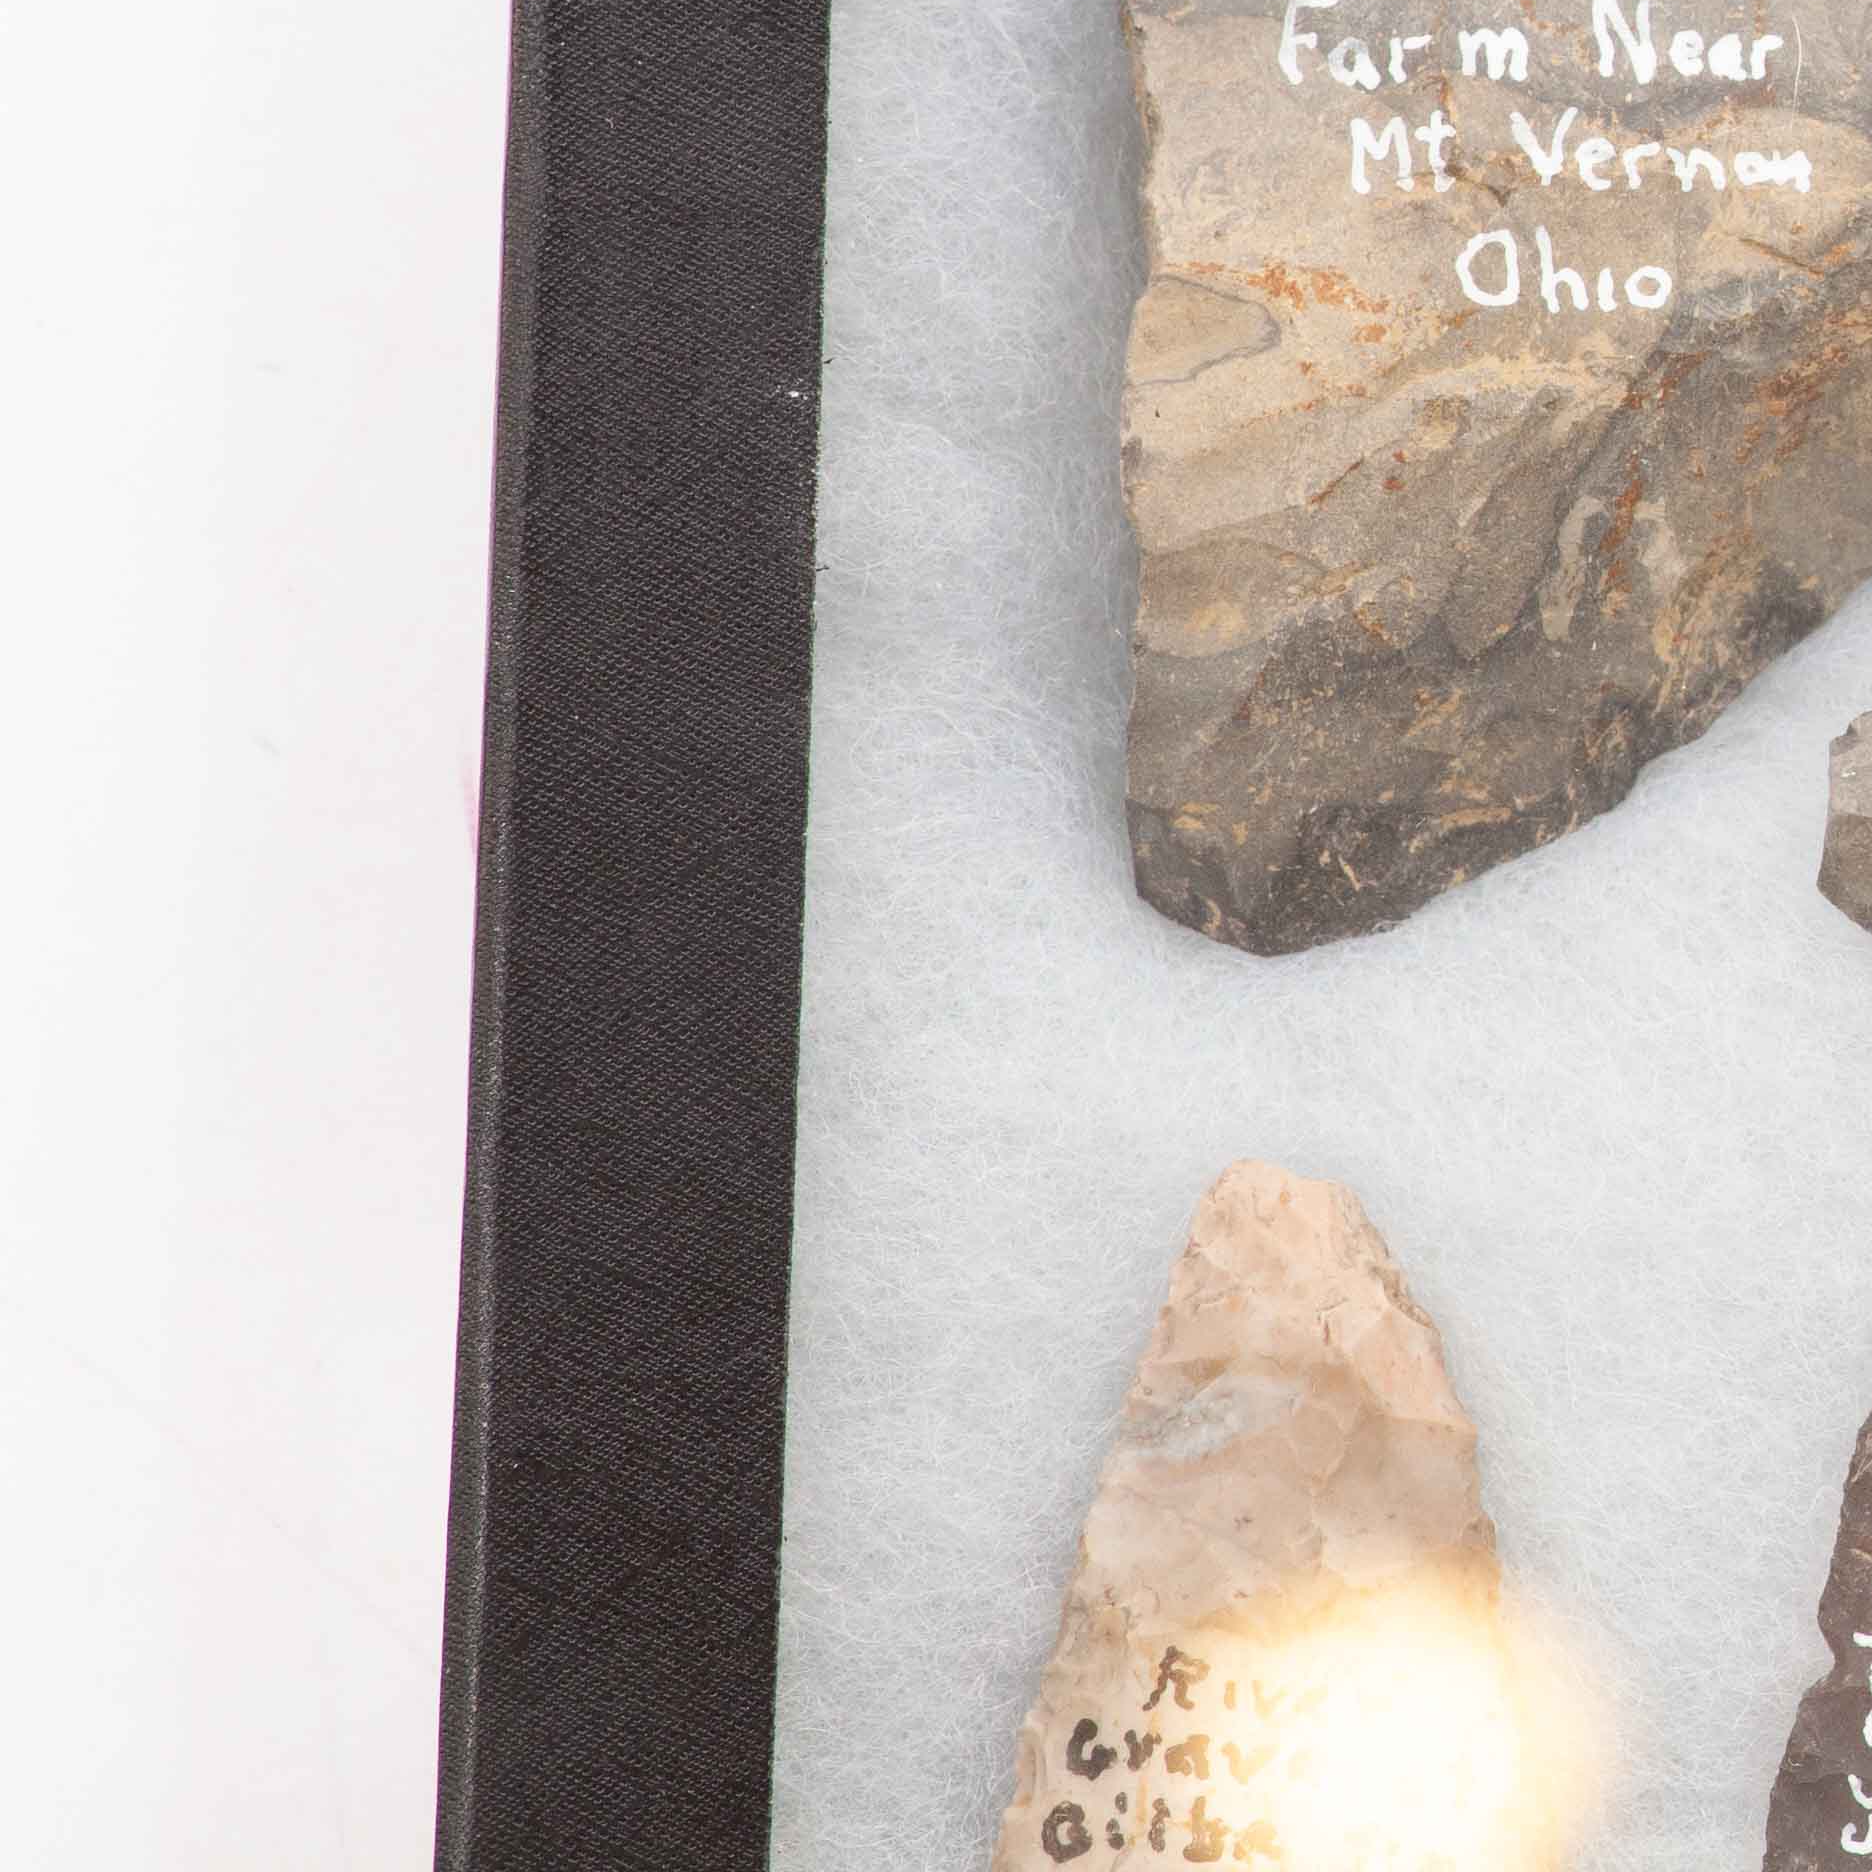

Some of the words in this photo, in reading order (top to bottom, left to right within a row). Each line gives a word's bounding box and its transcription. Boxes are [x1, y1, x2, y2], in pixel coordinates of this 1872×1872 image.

[1350, 110, 1456, 194] Mt
[1511, 107, 1812, 194] Vernon
[1455, 225, 1672, 314] Ohio
